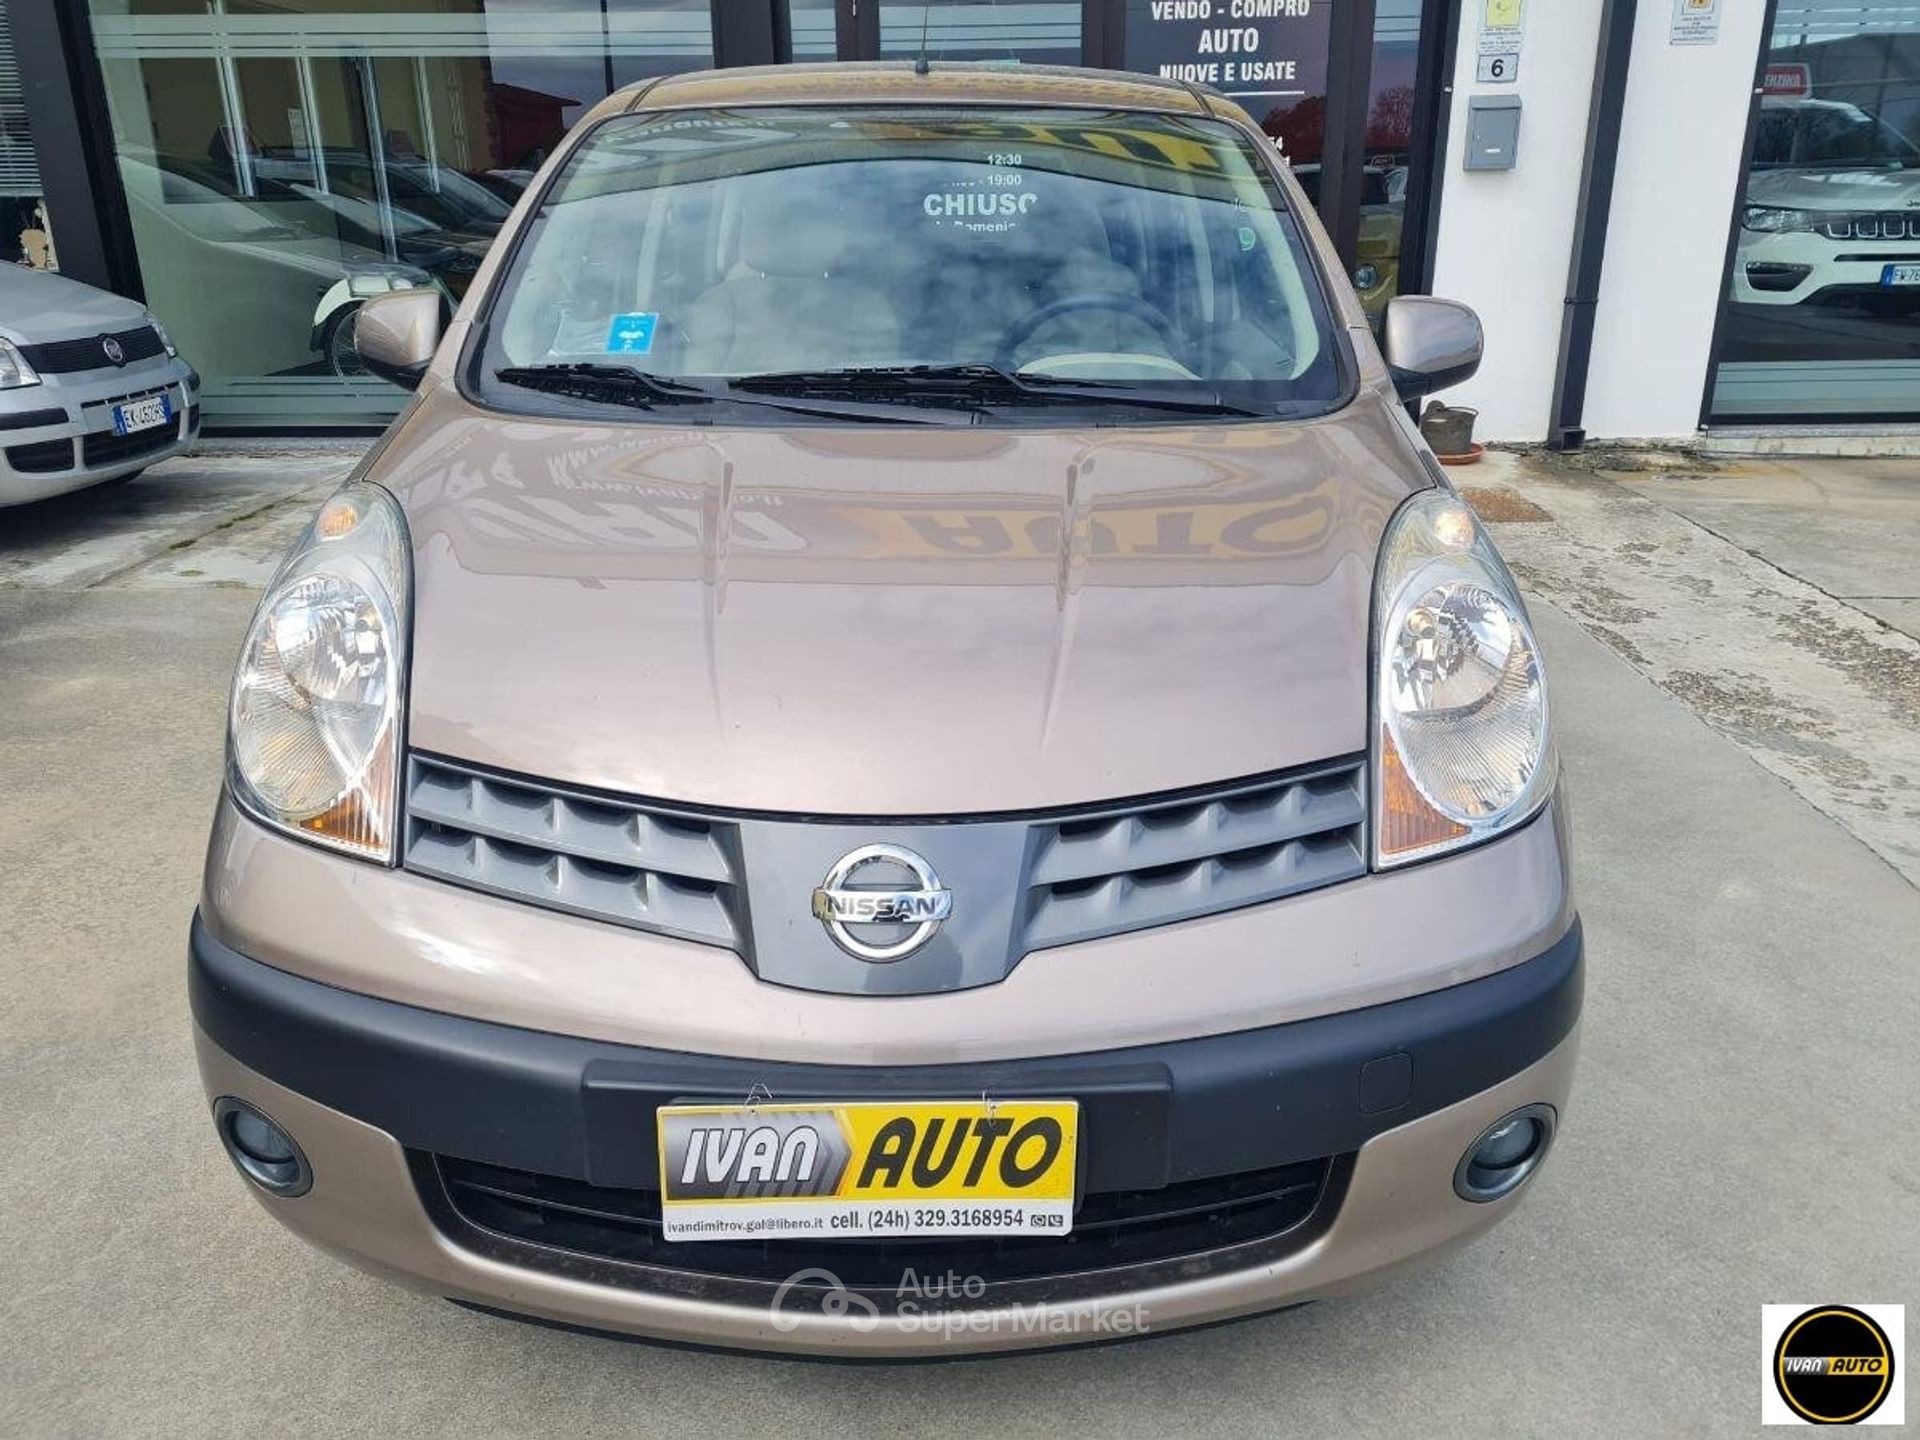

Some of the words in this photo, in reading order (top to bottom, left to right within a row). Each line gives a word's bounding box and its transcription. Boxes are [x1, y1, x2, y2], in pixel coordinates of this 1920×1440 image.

[1151, 1, 1211, 20] VENDO
[1230, 0, 1310, 18] COMPRO
[1198, 28, 1259, 53] AUTO
[1159, 63, 1218, 82] NUOVE
[1224, 63, 1235, 81] E
[1241, 61, 1296, 81] USATE
[1491, 59, 1504, 77] 6
[987, 154, 1022, 165] 12:30
[988, 174, 1022, 186] 19:00
[825, 897, 936, 916] NISSAN
[681, 1126, 820, 1184] IVAN
[856, 1117, 1063, 1188] AUTO
[830, 1211, 864, 1229] cell.
[868, 1210, 911, 1231] (24h)
[914, 1209, 1024, 1228] 329.3168954
